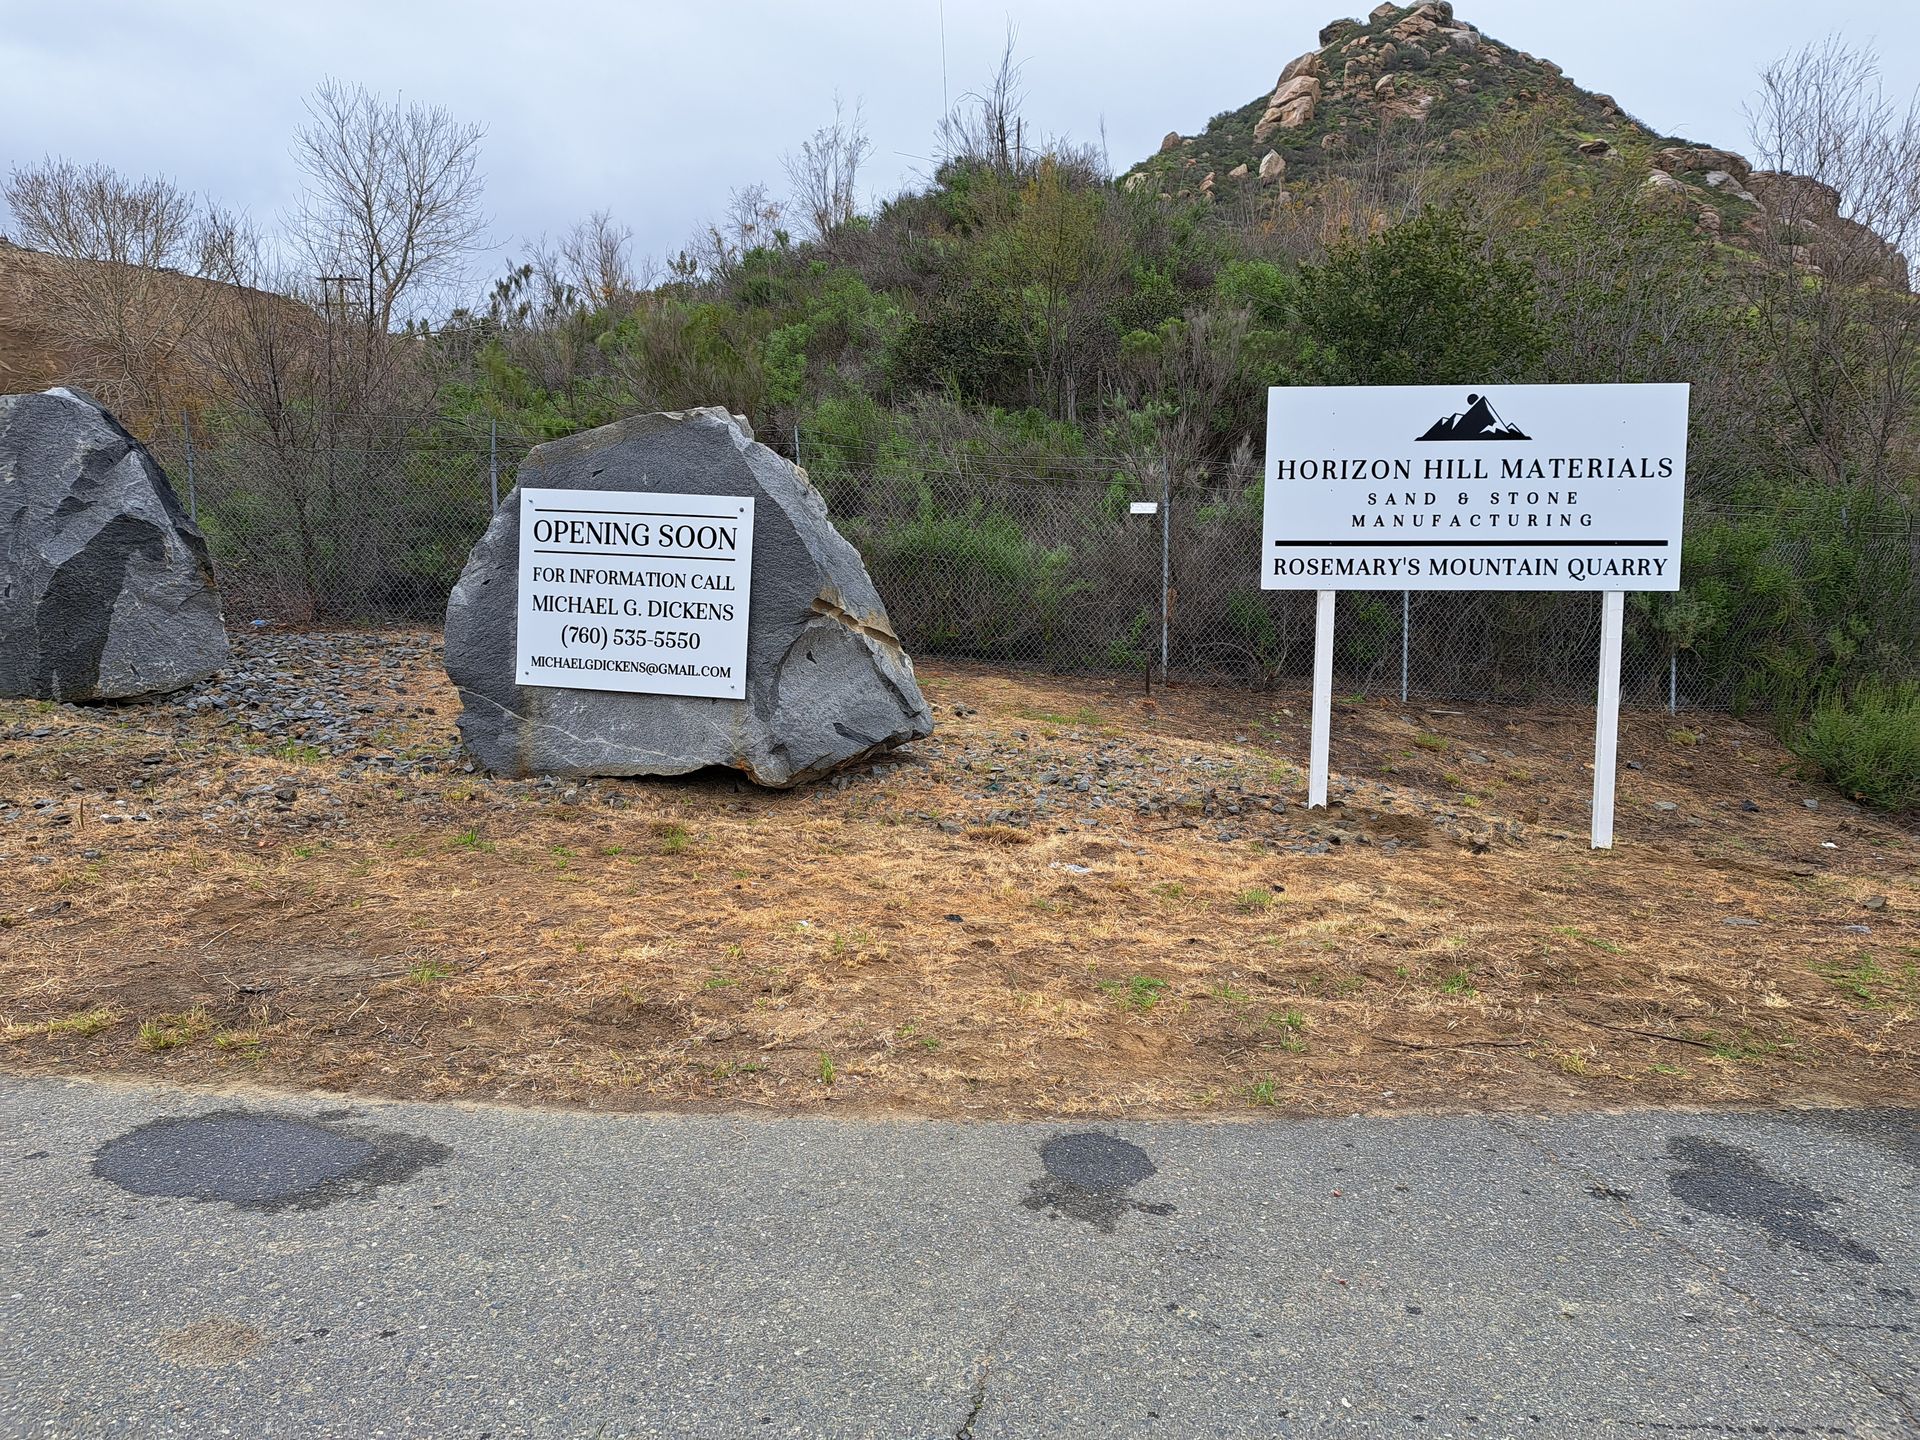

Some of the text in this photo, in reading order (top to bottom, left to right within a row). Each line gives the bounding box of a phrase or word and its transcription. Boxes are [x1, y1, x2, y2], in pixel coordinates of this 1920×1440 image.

[1277, 458, 1672, 479] HORIZON HILL MATERIALS
[1368, 492, 1577, 505] SAND & STONE
[1352, 514, 1591, 527] MANUFACTURING
[534, 520, 737, 550] OPENING SOON
[533, 567, 735, 591] FOR INFORMATION CALL
[1274, 557, 1668, 581] ROSEMARY'S MOUNTAIN QUARRY
[533, 595, 733, 621] MICHAEL G. DICKENS
[562, 625, 700, 650] (760) 535-5550
[531, 656, 731, 678] MICHAELGDICKENS@GMAIL.COM
